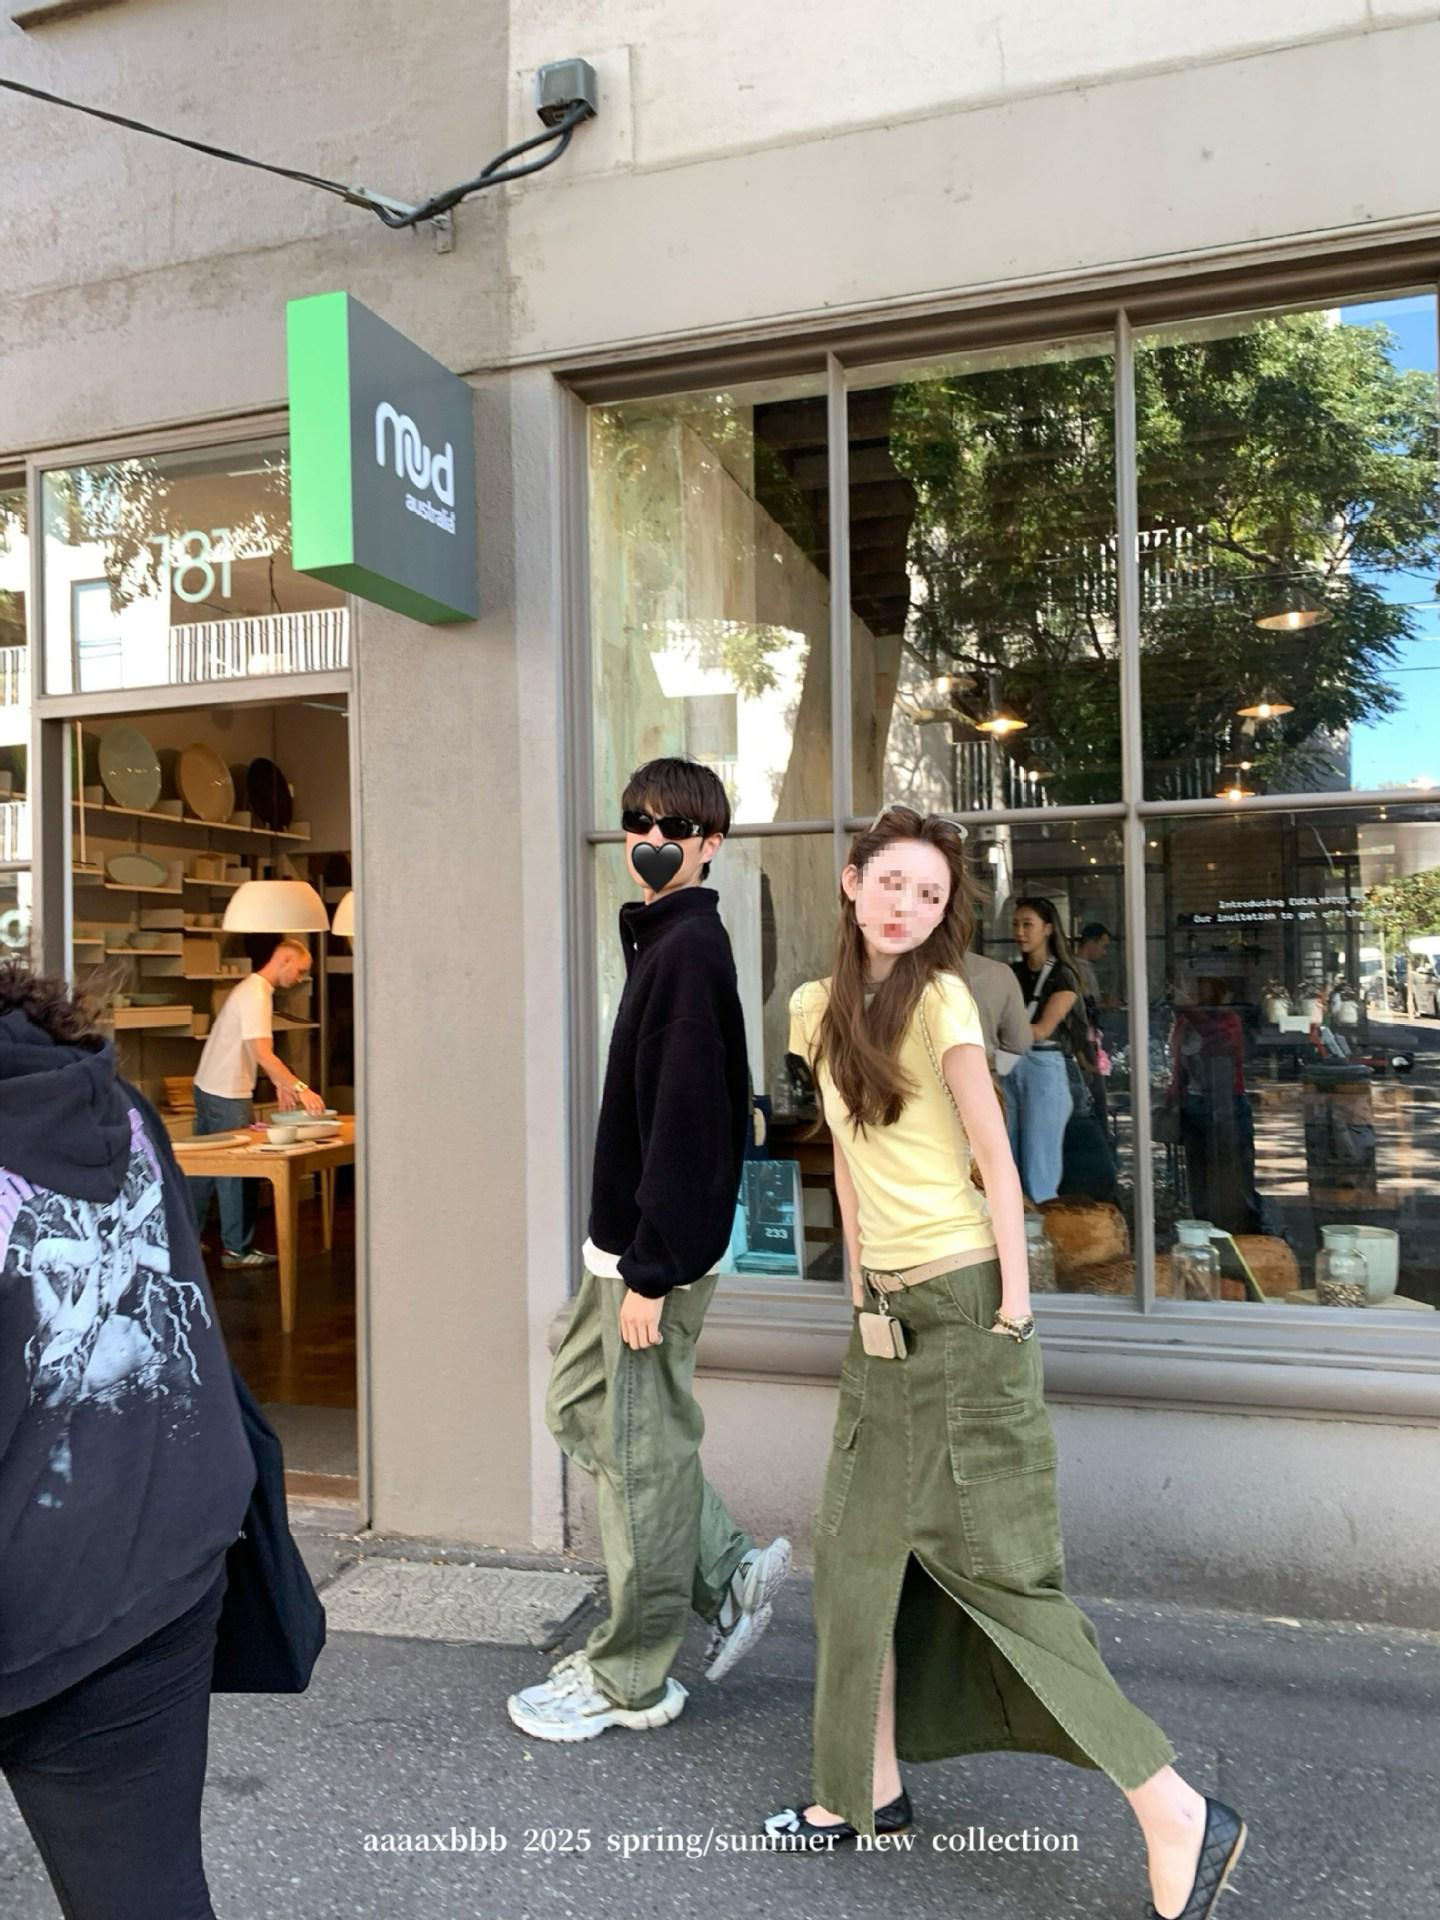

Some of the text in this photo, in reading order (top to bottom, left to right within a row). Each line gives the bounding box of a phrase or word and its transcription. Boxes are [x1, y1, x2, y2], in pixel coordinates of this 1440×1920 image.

[375, 401, 455, 507] mud
[405, 493, 456, 535] australia
[147, 528, 232, 603] 181
[1193, 914, 1212, 923] Our
[1217, 912, 1277, 922] invitation
[1281, 911, 1295, 920] to
[1298, 911, 1317, 921] get
[1218, 898, 1285, 909] Introducing
